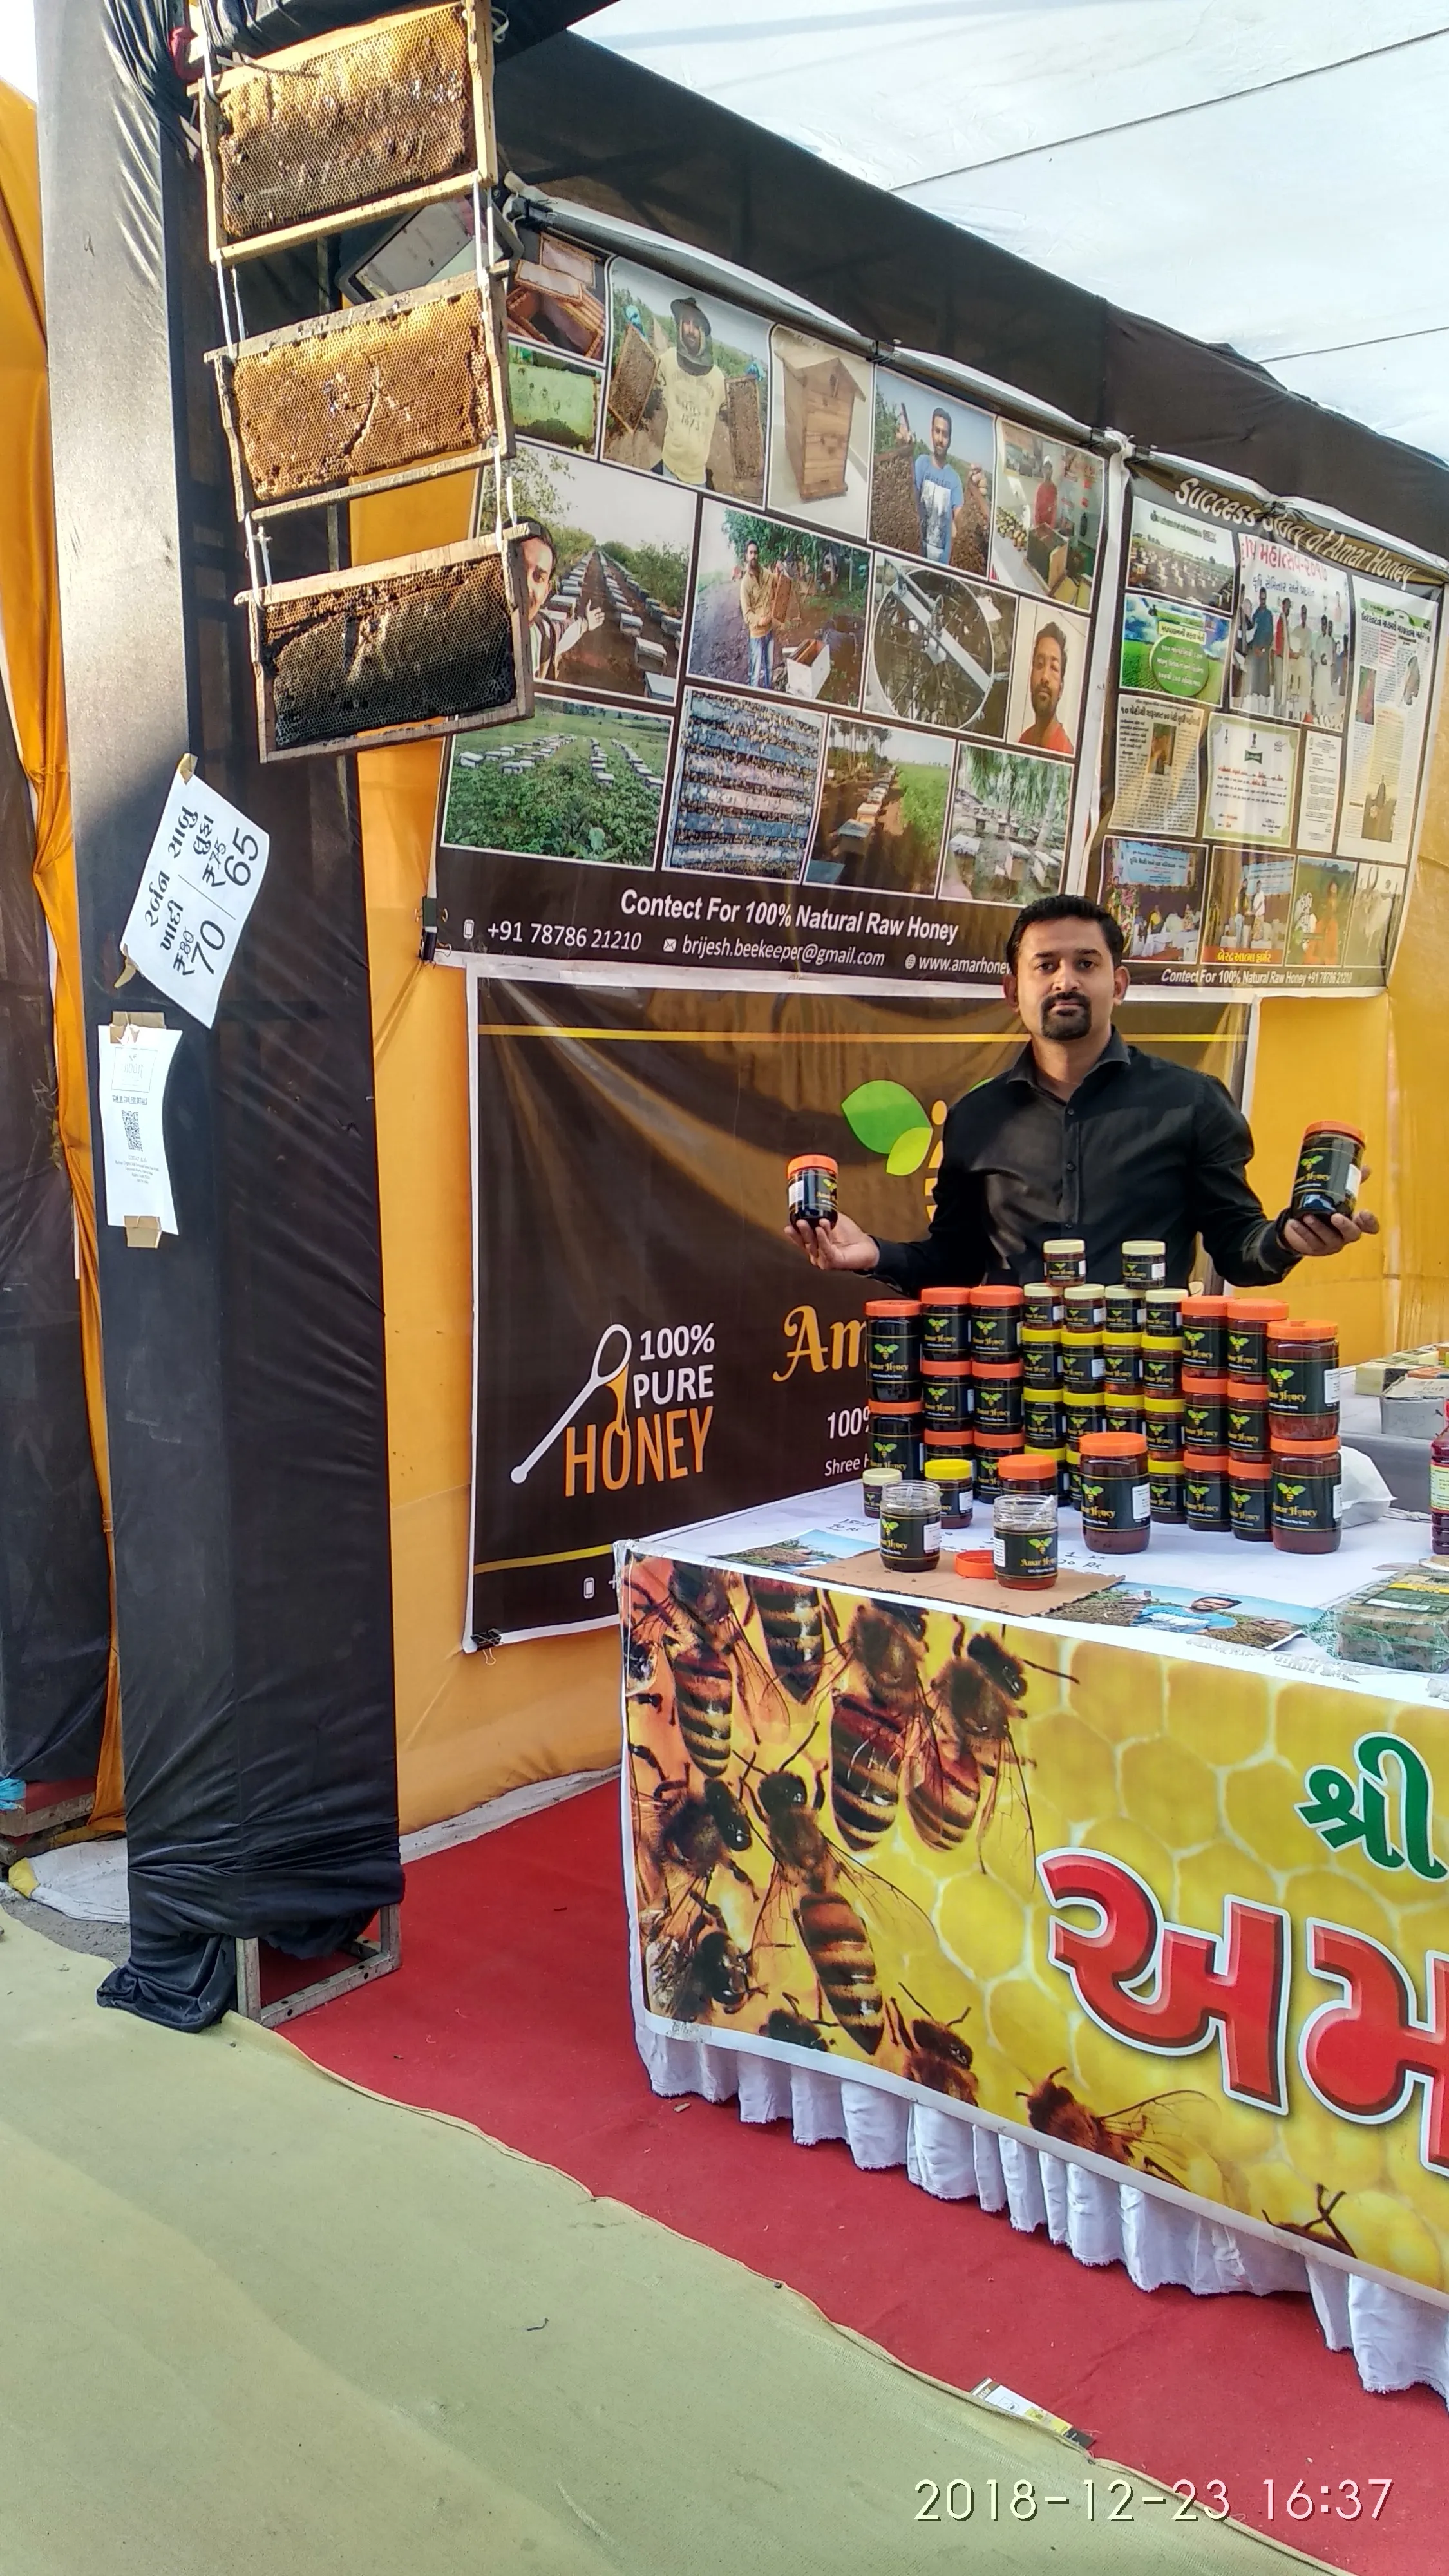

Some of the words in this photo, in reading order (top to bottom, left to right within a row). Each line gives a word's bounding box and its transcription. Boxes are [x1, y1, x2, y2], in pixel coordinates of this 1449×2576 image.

[1174, 478, 1263, 527] Success
[1305, 529, 1334, 554] of
[1323, 536, 1371, 574] Amar
[1370, 547, 1417, 591] Honey
[167, 806, 198, 858] સાબુ
[225, 827, 259, 887] 65
[160, 900, 184, 951] ખાદી
[620, 889, 702, 920] Contect
[706, 897, 740, 923] For
[745, 901, 792, 927] 100%
[795, 904, 864, 933] Natural
[866, 911, 905, 936] Raw
[906, 915, 959, 945] Honey
[191, 920, 225, 975] 70
[487, 920, 523, 942] +91
[530, 923, 588, 947] 78786
[590, 928, 643, 951] 21210
[682, 934, 886, 967] brijesh.beekeeper@gmail.com
[1160, 968, 1200, 983] Contect
[1200, 969, 1216, 983] For
[1218, 969, 1241, 984] 100%
[1242, 970, 1270, 984] Natural
[1269, 971, 1285, 984] Raw
[1285, 971, 1307, 987] Honey
[1307, 972, 1319, 984] +91
[639, 1322, 716, 1362] 100%
[772, 1304, 867, 1382] Am
[632, 1363, 715, 1410] PURE
[564, 1405, 714, 1497] HONEY
[824, 1455, 860, 1478] Shree
[1289, 1503, 1318, 1517] Honey
[1019, 1558, 1040, 1567] Amar
[1294, 1732, 1448, 1882] શ્રી
